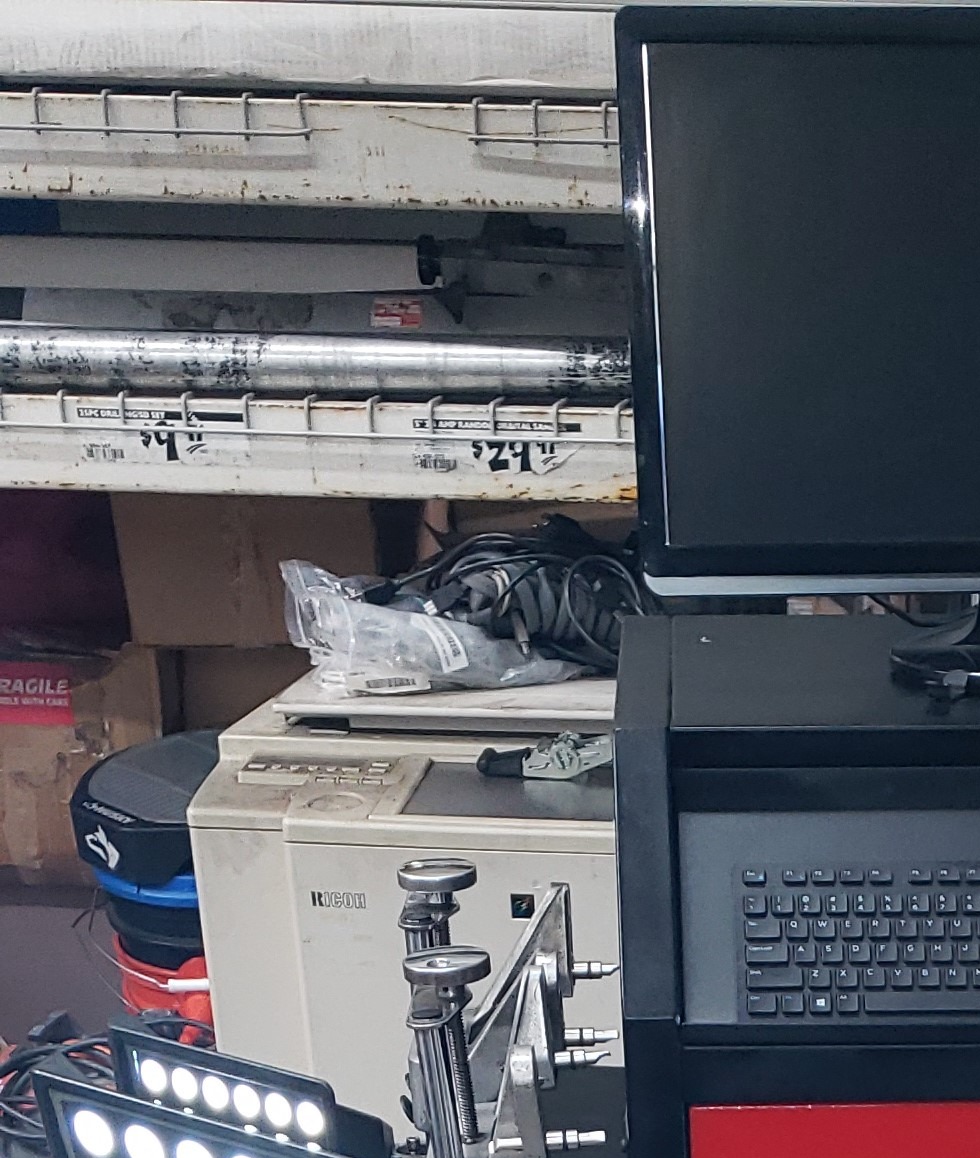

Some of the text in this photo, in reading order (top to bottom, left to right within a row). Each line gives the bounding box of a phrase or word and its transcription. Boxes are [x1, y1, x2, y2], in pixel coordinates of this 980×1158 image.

[457, 421, 492, 430] RANDO
[310, 890, 367, 910] RICOH
[790, 920, 798, 928] Q
[818, 920, 828, 928] W
[845, 920, 851, 928] E
[899, 919, 906, 927] T
[953, 919, 961, 927] U
[825, 944, 832, 952] S
[880, 944, 886, 952] F
[907, 944, 914, 952] G
[812, 969, 819, 977] Z
[840, 969, 847, 977] X
[866, 968, 874, 976] C
[922, 968, 929, 976] B
